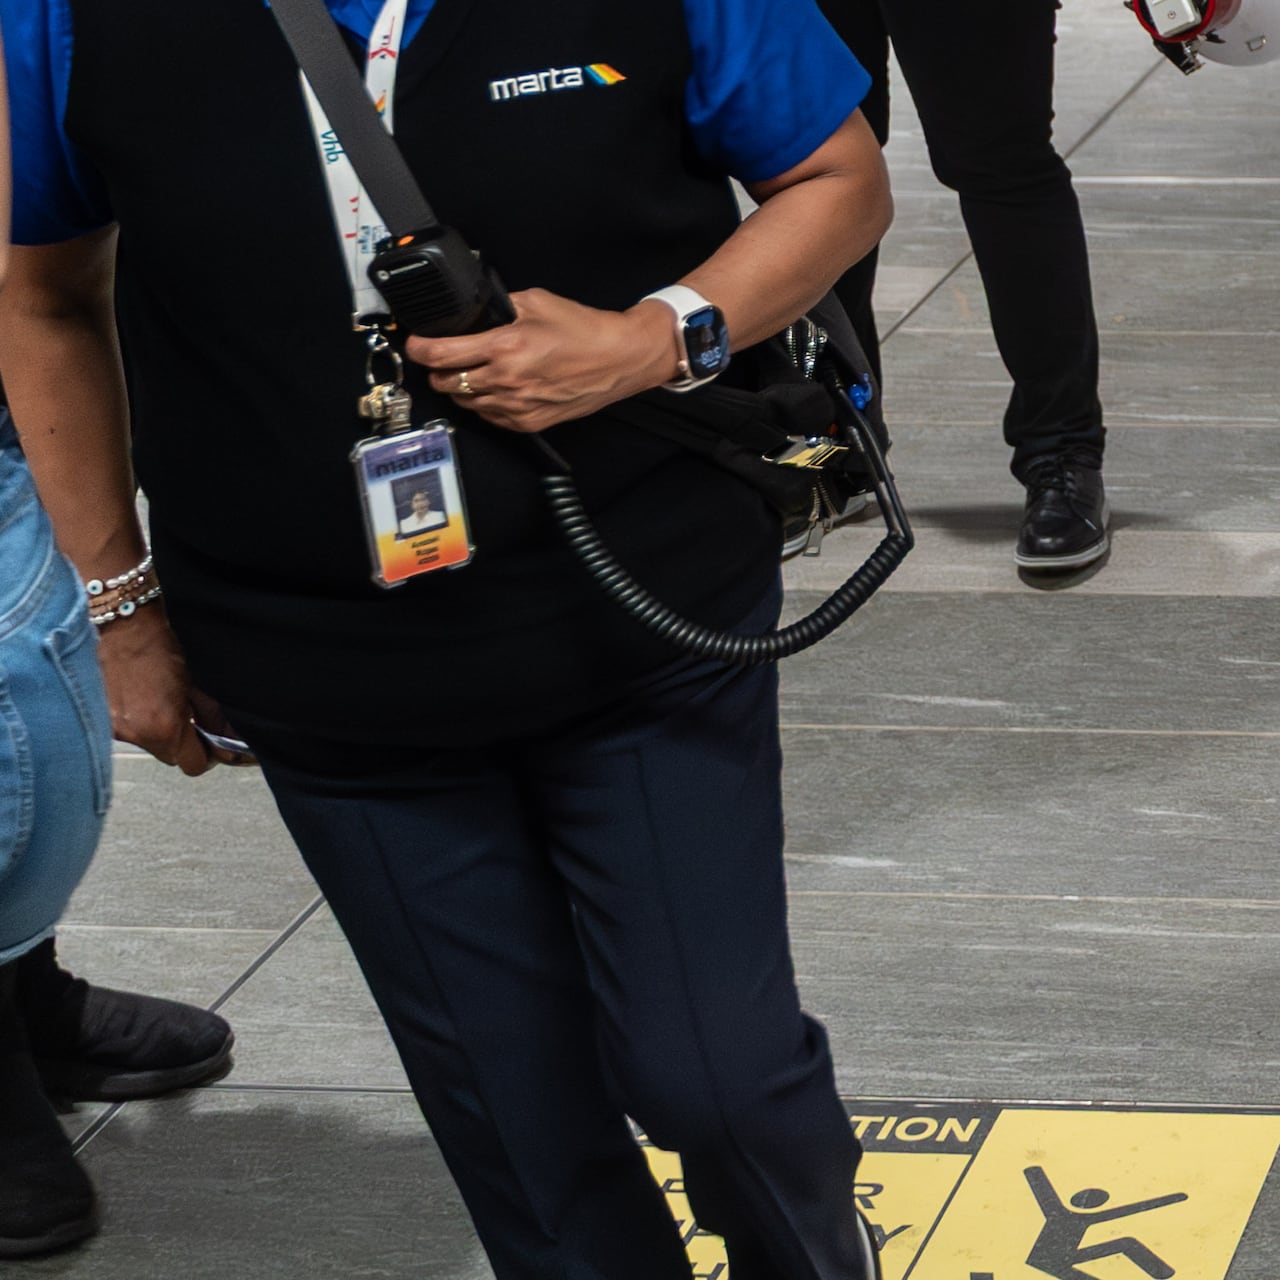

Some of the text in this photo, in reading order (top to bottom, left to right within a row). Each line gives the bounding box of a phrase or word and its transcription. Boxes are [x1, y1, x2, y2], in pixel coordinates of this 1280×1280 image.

[489, 66, 584, 101] marta
[375, 446, 444, 478] marta
[849, 1114, 981, 1142] TION
